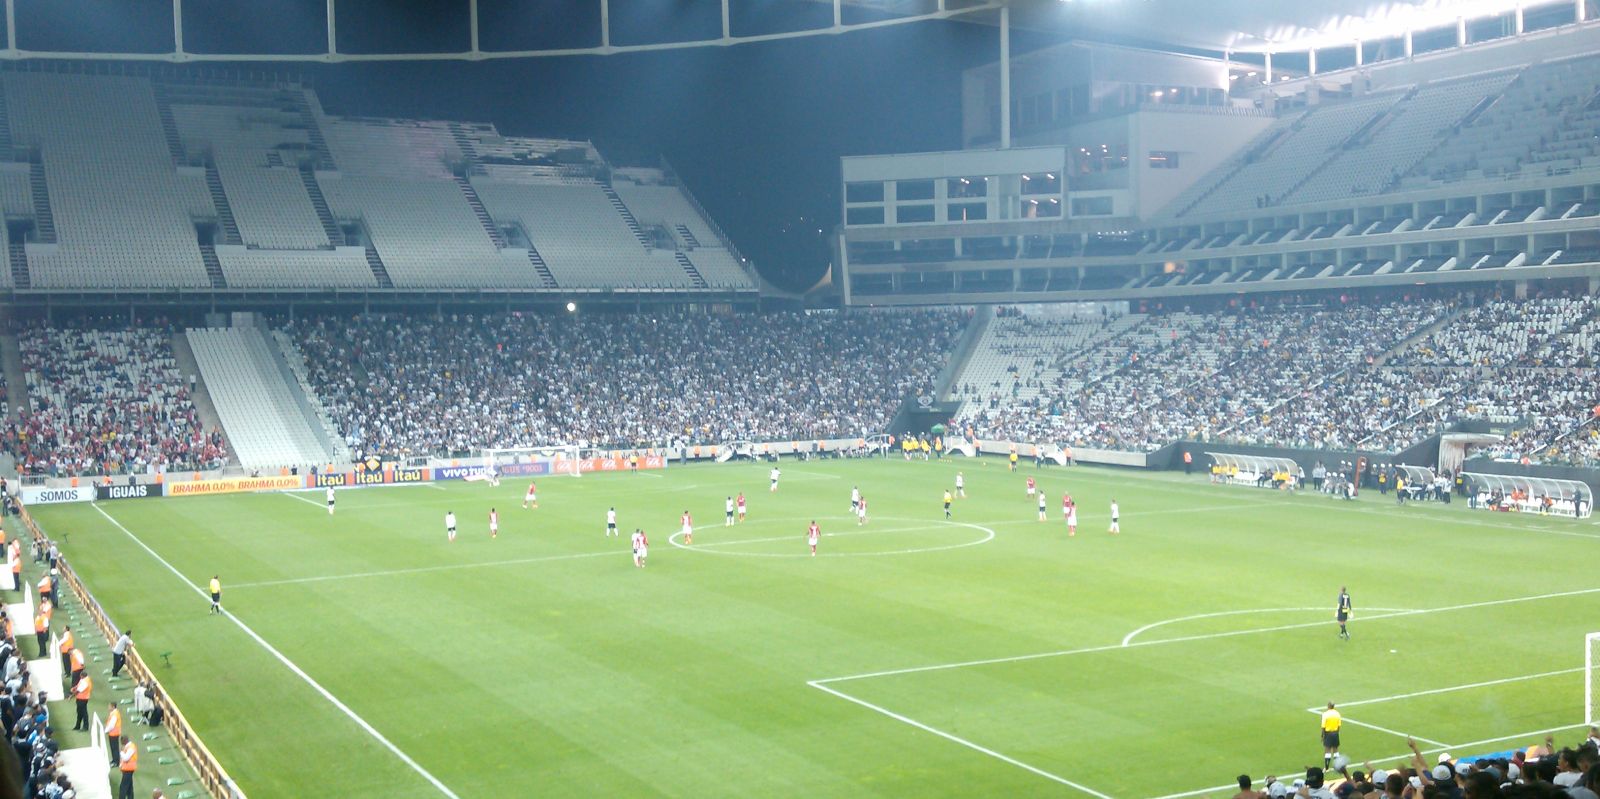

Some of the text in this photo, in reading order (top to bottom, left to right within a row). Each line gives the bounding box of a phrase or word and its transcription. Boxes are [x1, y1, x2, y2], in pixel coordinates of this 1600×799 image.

[356, 471, 383, 484] Itaú
[395, 469, 420, 481] Itaú
[443, 467, 468, 477] VIVO
[317, 473, 344, 486] Itaú
[109, 486, 147, 498] IGUAIS
[173, 483, 210, 493] BRAHMA
[238, 480, 274, 489] BRAHMA
[40, 490, 78, 501] SOMOS
